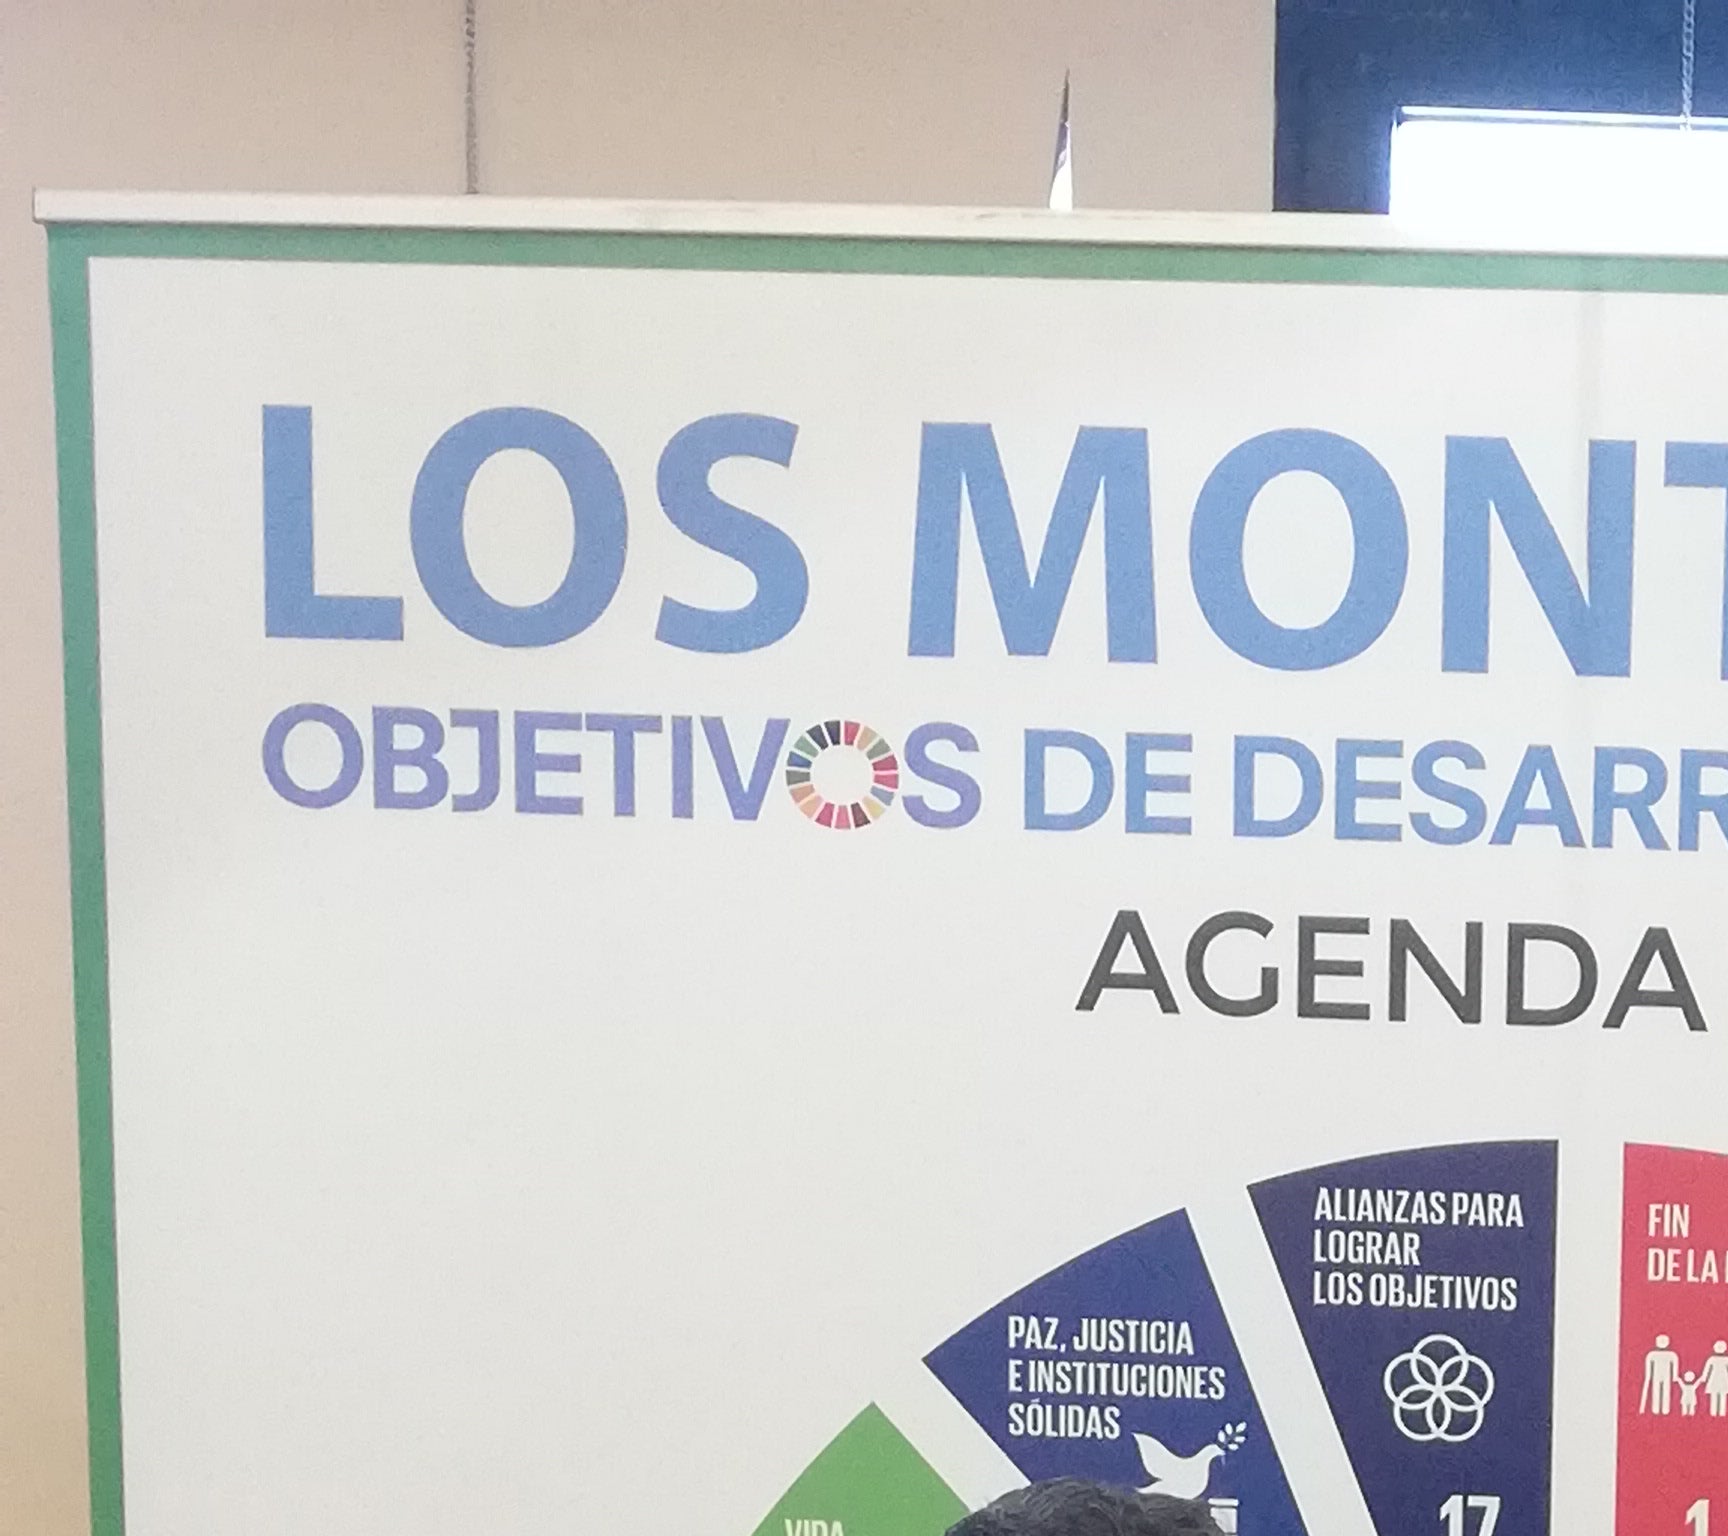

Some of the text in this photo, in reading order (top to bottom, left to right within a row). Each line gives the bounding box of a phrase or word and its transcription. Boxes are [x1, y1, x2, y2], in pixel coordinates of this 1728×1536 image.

[262, 404, 810, 655] LOS
[262, 700, 981, 831] OBJETIVOS
[1025, 729, 1194, 836] DE
[1076, 910, 1708, 1034] AGENDA
[1314, 1187, 1524, 1228] ALIANZAS PARA
[1648, 1203, 1689, 1238] FIN
[1313, 1229, 1421, 1267] LOGRAR
[1647, 1248, 1681, 1282] DE
[1686, 1250, 1720, 1284] LA
[1313, 1271, 1518, 1312] LOS OBJETIVOS
[1008, 1315, 1194, 1356] PAZ, JUSTICIA
[1009, 1360, 1226, 1401] E INSTITUCIONES
[1008, 1396, 1121, 1439] SÓLIDAS
